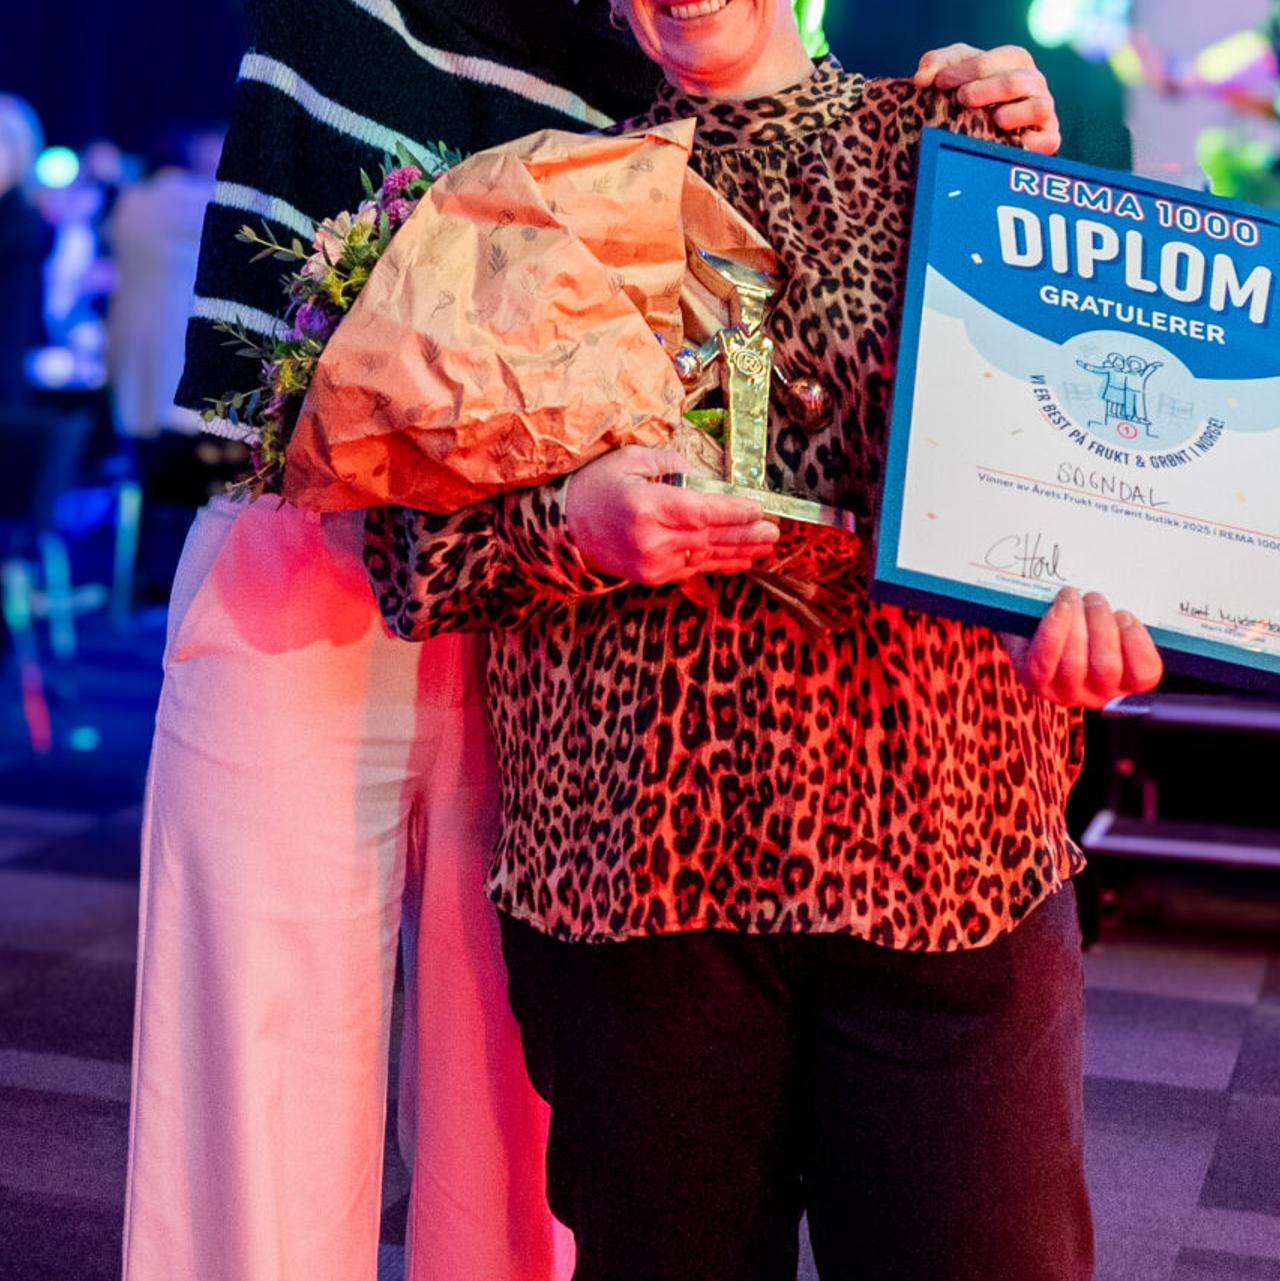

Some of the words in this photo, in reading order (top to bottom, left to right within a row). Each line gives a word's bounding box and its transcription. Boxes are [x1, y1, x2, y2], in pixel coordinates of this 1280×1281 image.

[1009, 166, 1145, 221] REMA
[1155, 199, 1260, 247] 1000
[996, 205, 1272, 325] DIPLOM
[1039, 284, 1226, 345] GRATULERER
[1033, 387, 1051, 402] ER
[1042, 404, 1071, 431] BEST
[1068, 428, 1090, 447] PÅ
[1087, 440, 1130, 466] FRUKT
[1134, 454, 1147, 469] &
[1149, 449, 1193, 470] GRØNT
[977, 471, 1014, 488] Vinner
[1016, 482, 1030, 493] av
[1032, 484, 1062, 500] Årets
[1063, 492, 1093, 508] Frukt
[1095, 502, 1109, 513] og
[1110, 504, 1143, 519] Grønt
[1145, 512, 1180, 528] butikk
[1182, 521, 1212, 535] 2025
[1219, 529, 1256, 545] REMA
